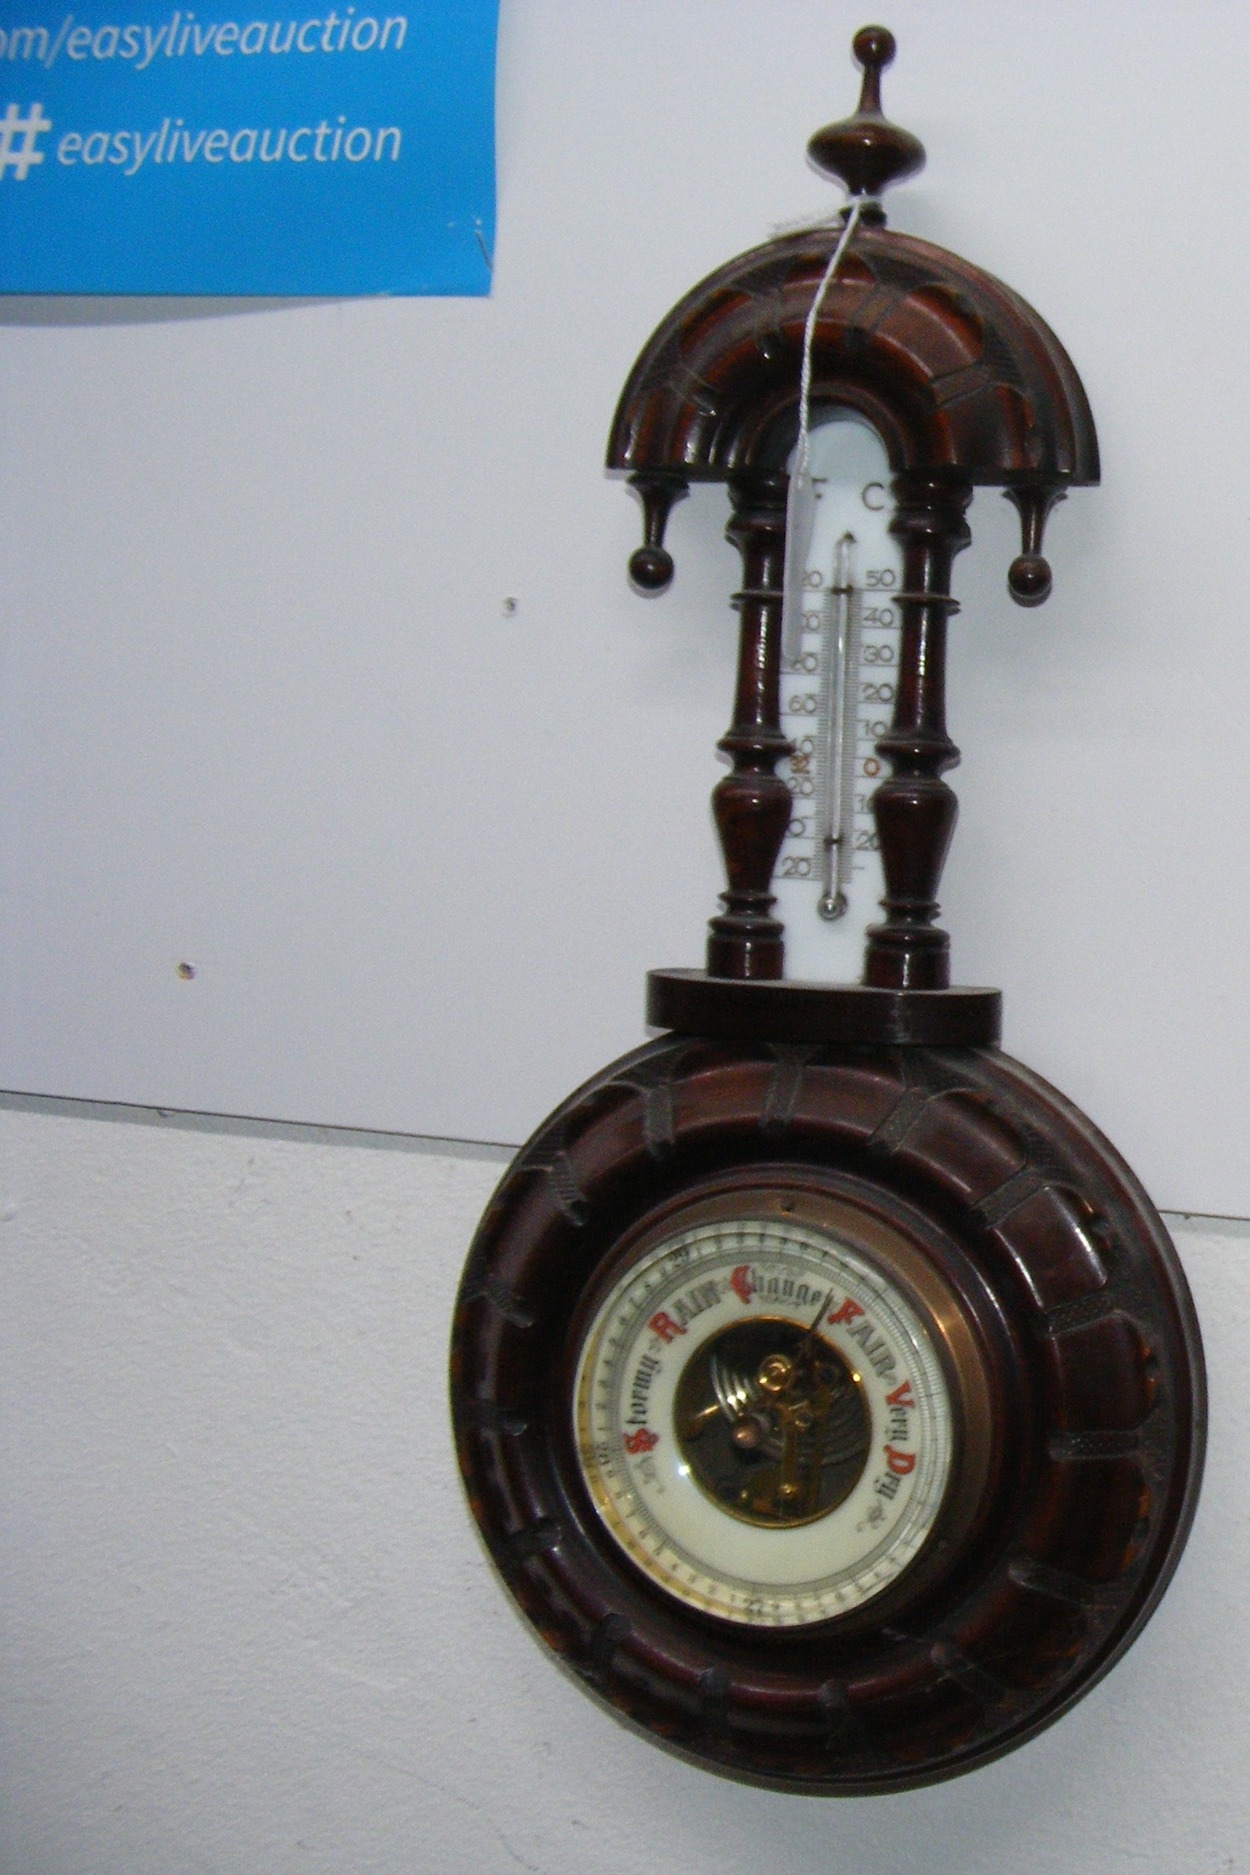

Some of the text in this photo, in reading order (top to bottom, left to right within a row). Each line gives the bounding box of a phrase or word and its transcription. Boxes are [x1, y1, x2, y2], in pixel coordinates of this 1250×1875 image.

[861, 481, 885, 511] C
[865, 569, 896, 587] 50
[864, 607, 894, 627] 40
[864, 645, 894, 663] 30
[863, 683, 893, 702] 20
[788, 694, 816, 713] 60
[863, 757, 880, 777] 0
[781, 855, 811, 877] 20
[729, 1264, 823, 1307] Change
[827, 1297, 897, 1380] FAIR
[873, 1379, 917, 1500] Very Dry
